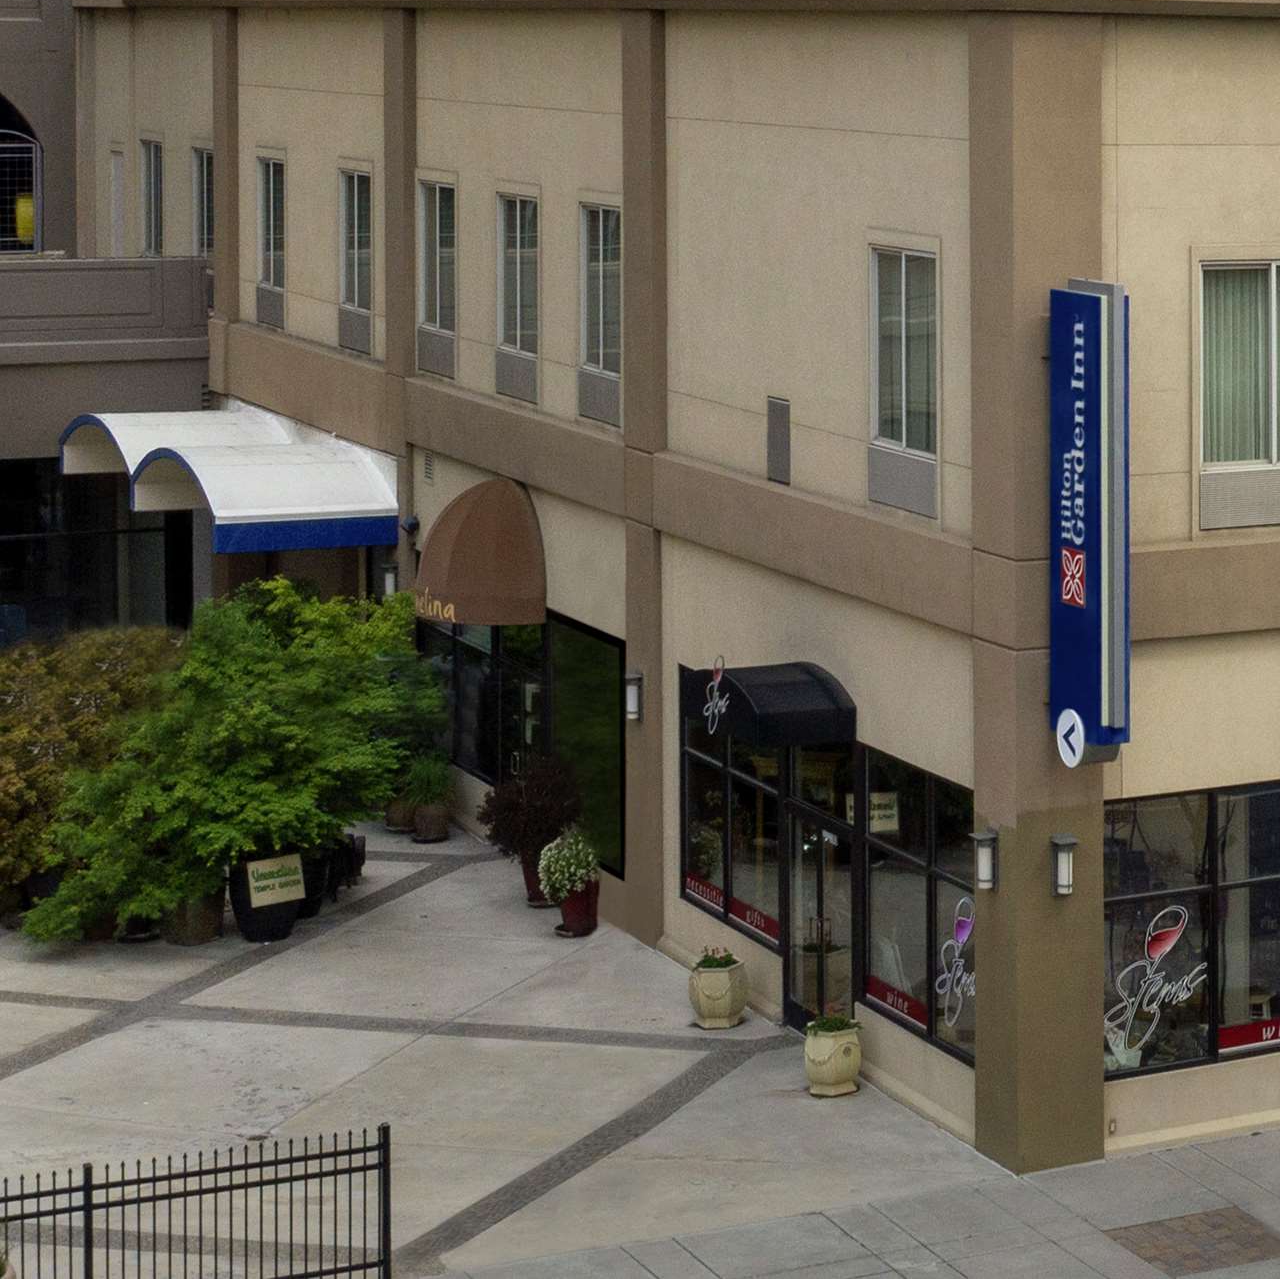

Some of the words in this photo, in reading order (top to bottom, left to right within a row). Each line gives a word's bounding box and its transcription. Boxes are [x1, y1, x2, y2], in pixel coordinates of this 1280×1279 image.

[1071, 321, 1085, 391] Inn
[1061, 452, 1073, 539] Hilton
[1071, 400, 1085, 545] Garden
[886, 992, 909, 1014] wine
